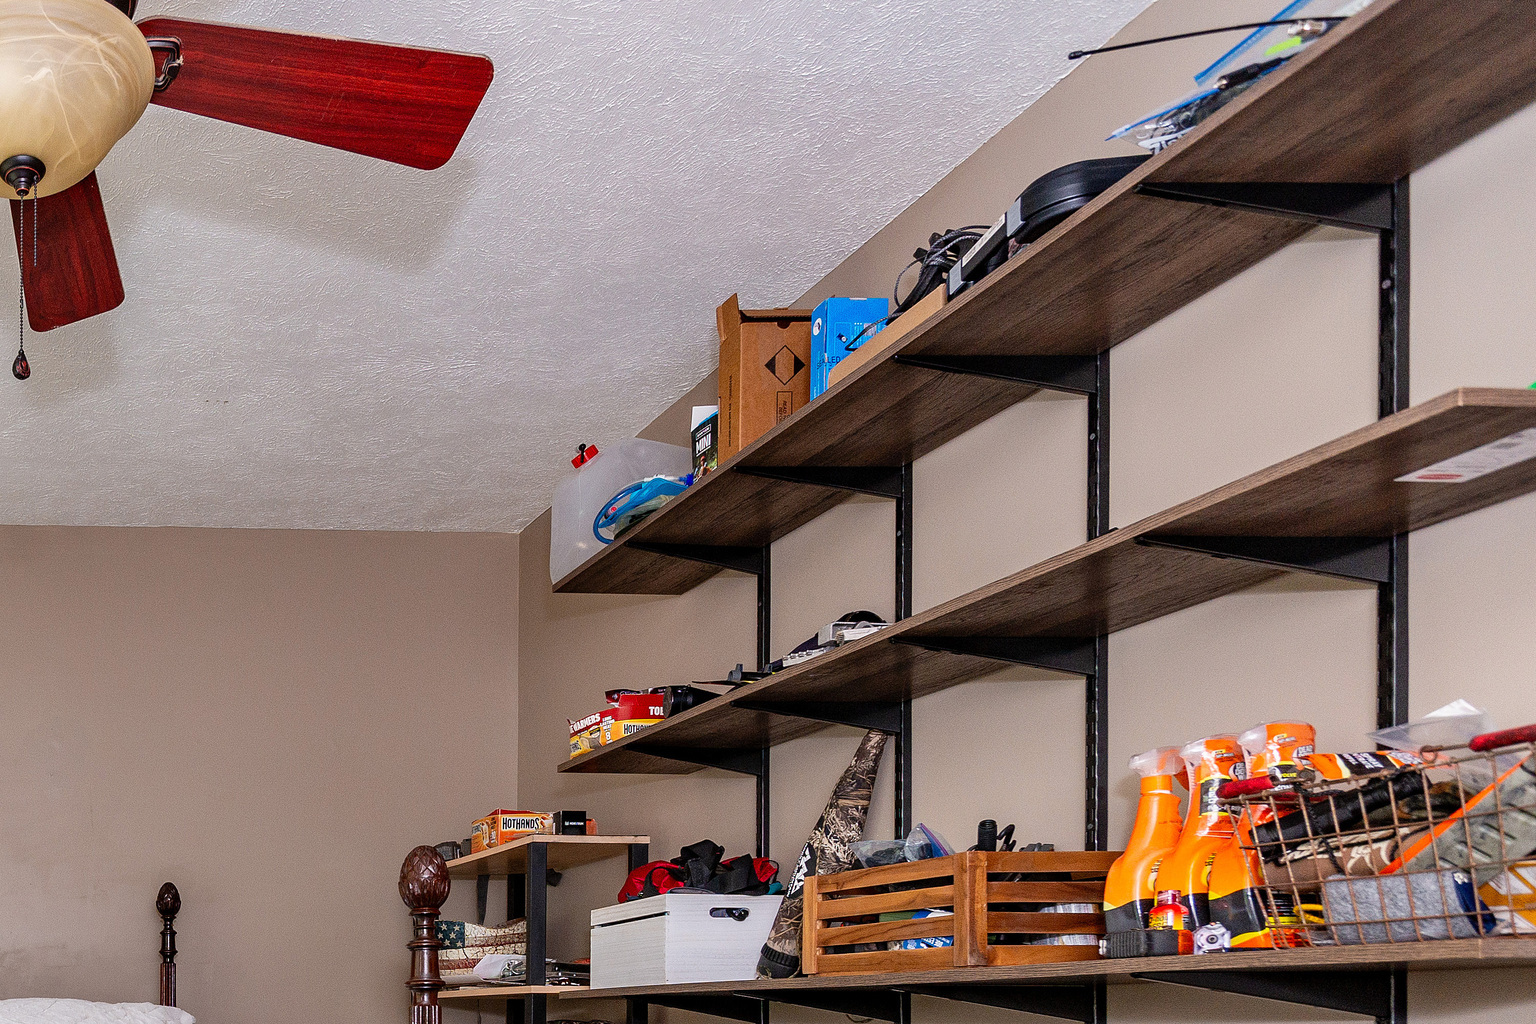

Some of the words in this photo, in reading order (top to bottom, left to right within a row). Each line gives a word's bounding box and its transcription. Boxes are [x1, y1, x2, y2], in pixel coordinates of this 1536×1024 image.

[695, 433, 712, 454] MINI
[573, 713, 601, 731] WARMERS
[605, 732, 611, 741] 8
[502, 817, 540, 830] HOTHANDS
